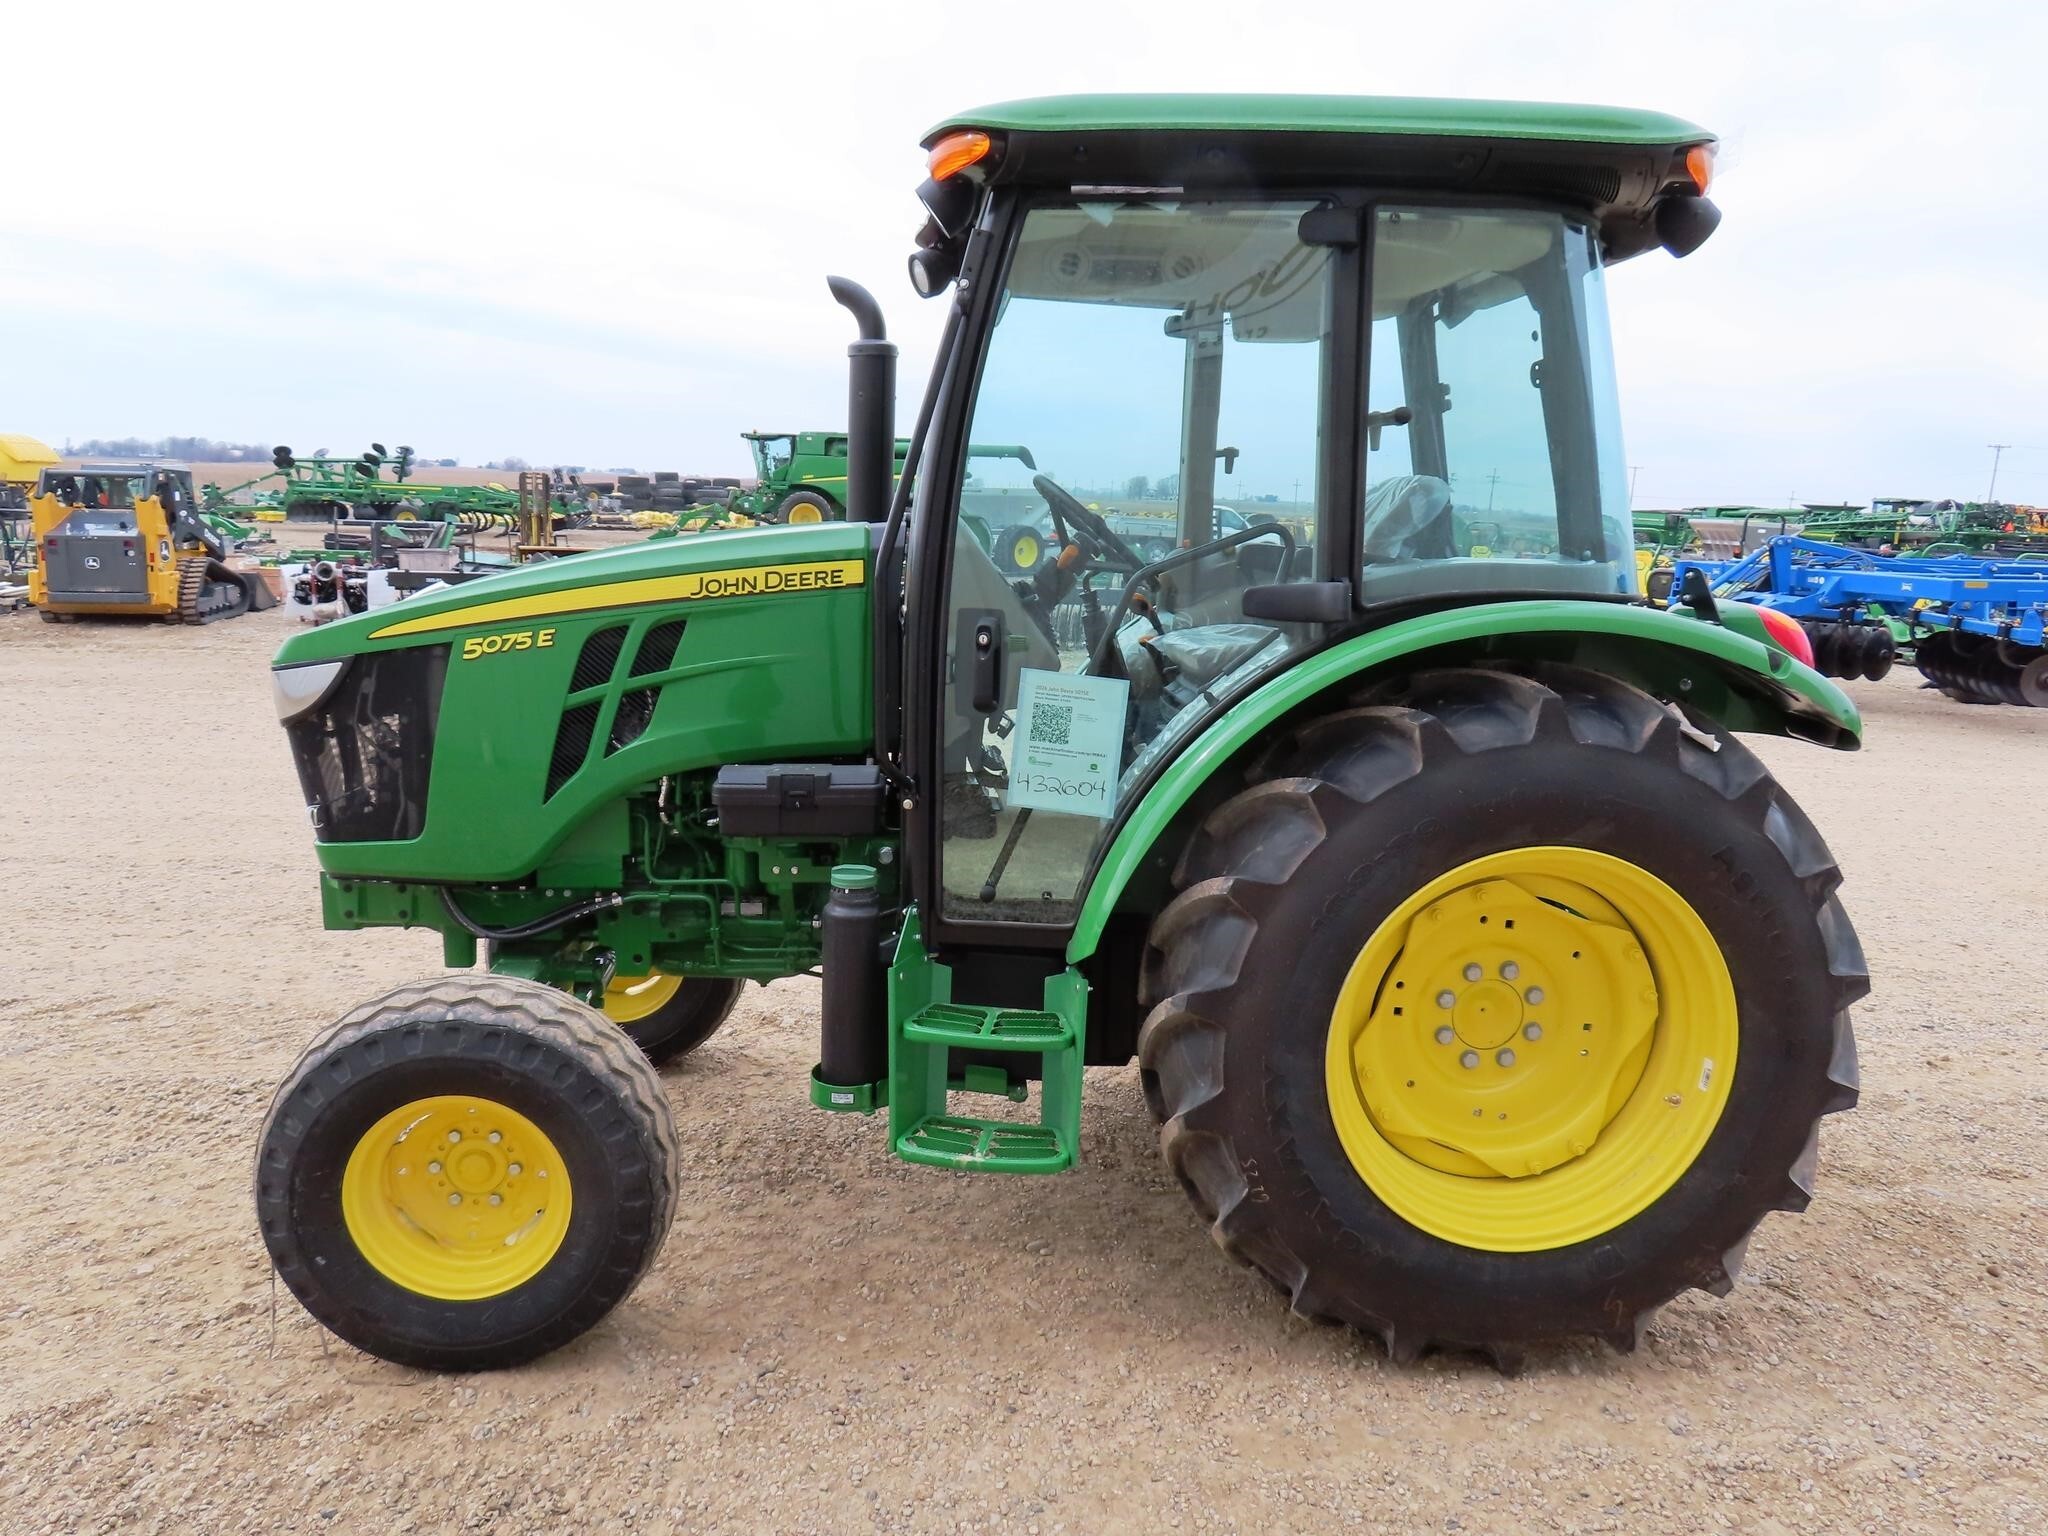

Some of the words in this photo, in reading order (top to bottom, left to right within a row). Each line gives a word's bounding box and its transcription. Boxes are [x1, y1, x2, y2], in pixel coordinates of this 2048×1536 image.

[690, 575, 758, 597] JOHN
[764, 569, 844, 590] DEERE
[462, 631, 533, 661] 5075
[536, 628, 556, 648] E
[1017, 773, 1106, 801] 432604
